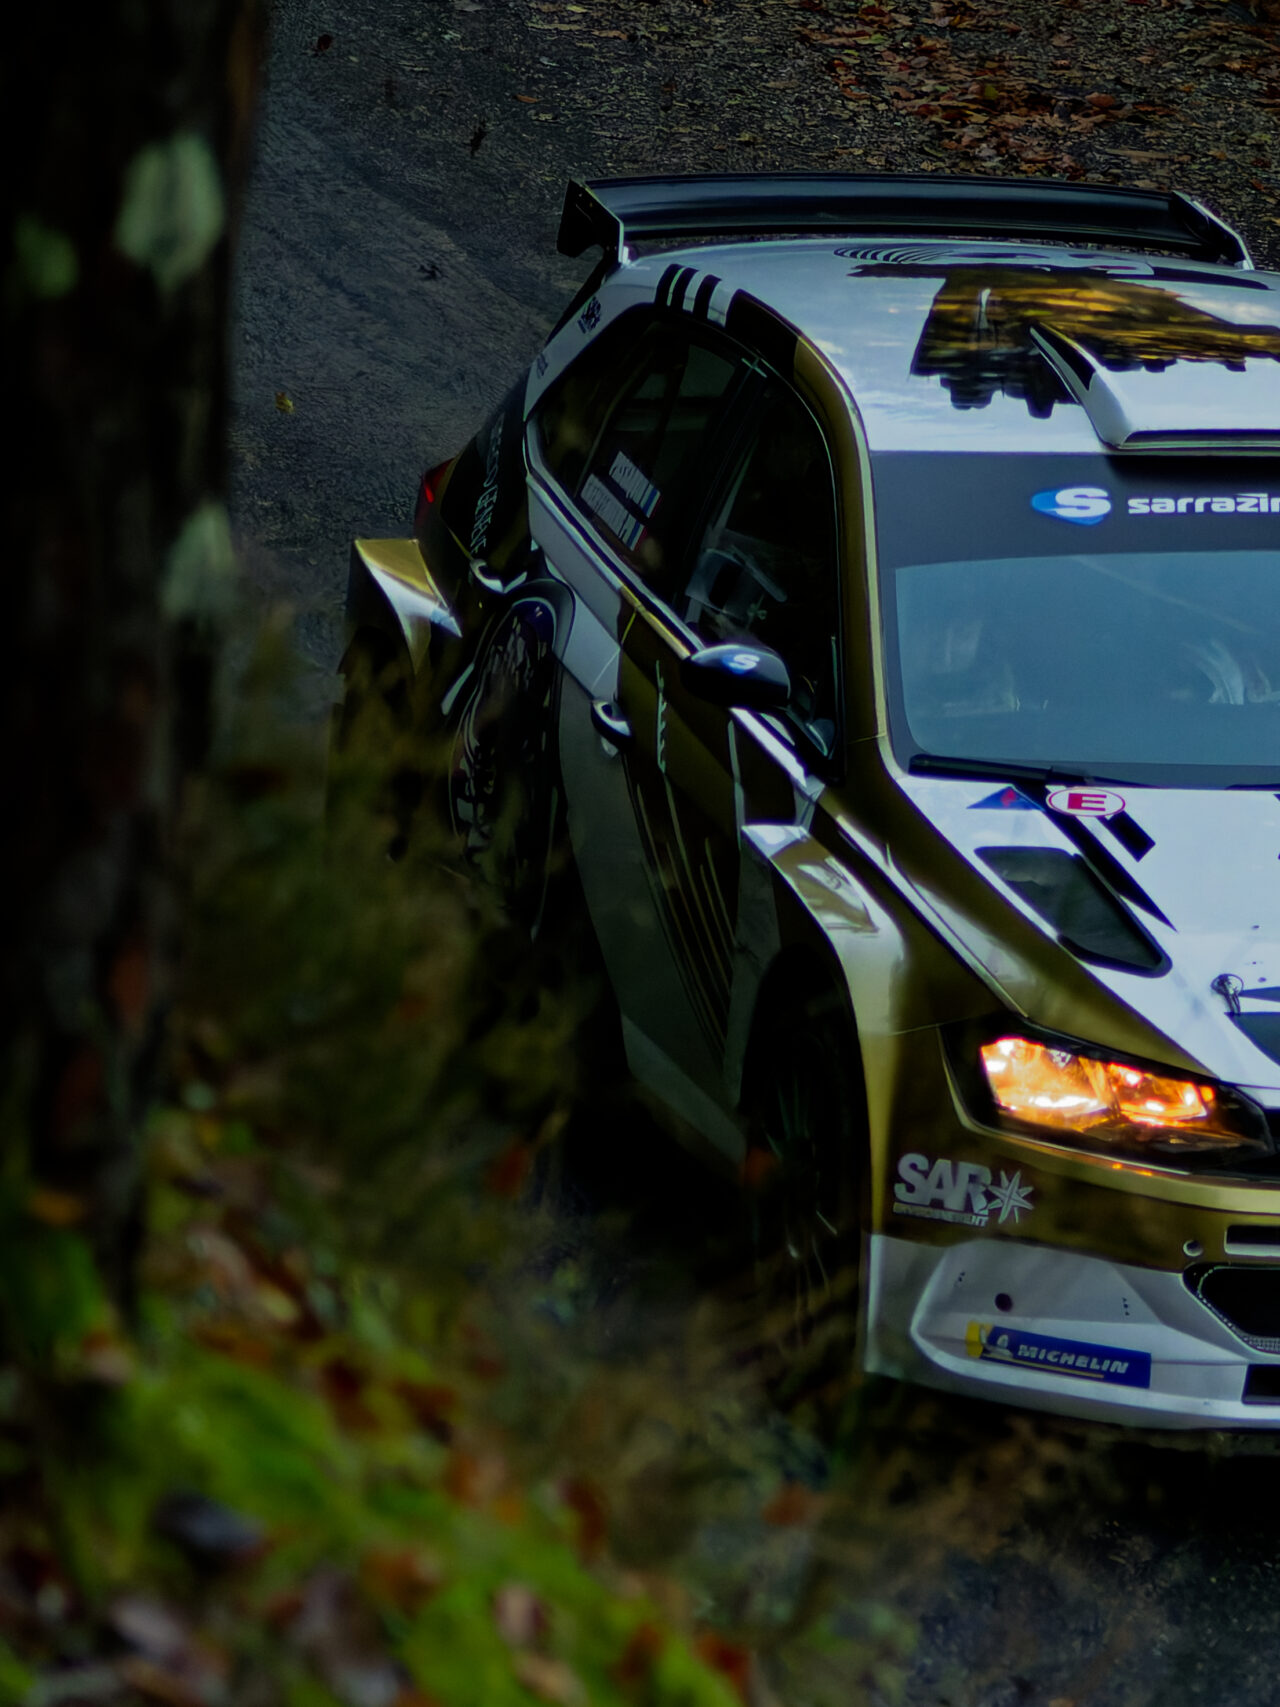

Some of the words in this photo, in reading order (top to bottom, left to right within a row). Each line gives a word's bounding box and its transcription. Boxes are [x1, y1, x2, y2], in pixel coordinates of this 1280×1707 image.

[1067, 793, 1107, 811] E
[893, 1152, 992, 1214] SAR
[1017, 1343, 1130, 1375] MICHELIN
